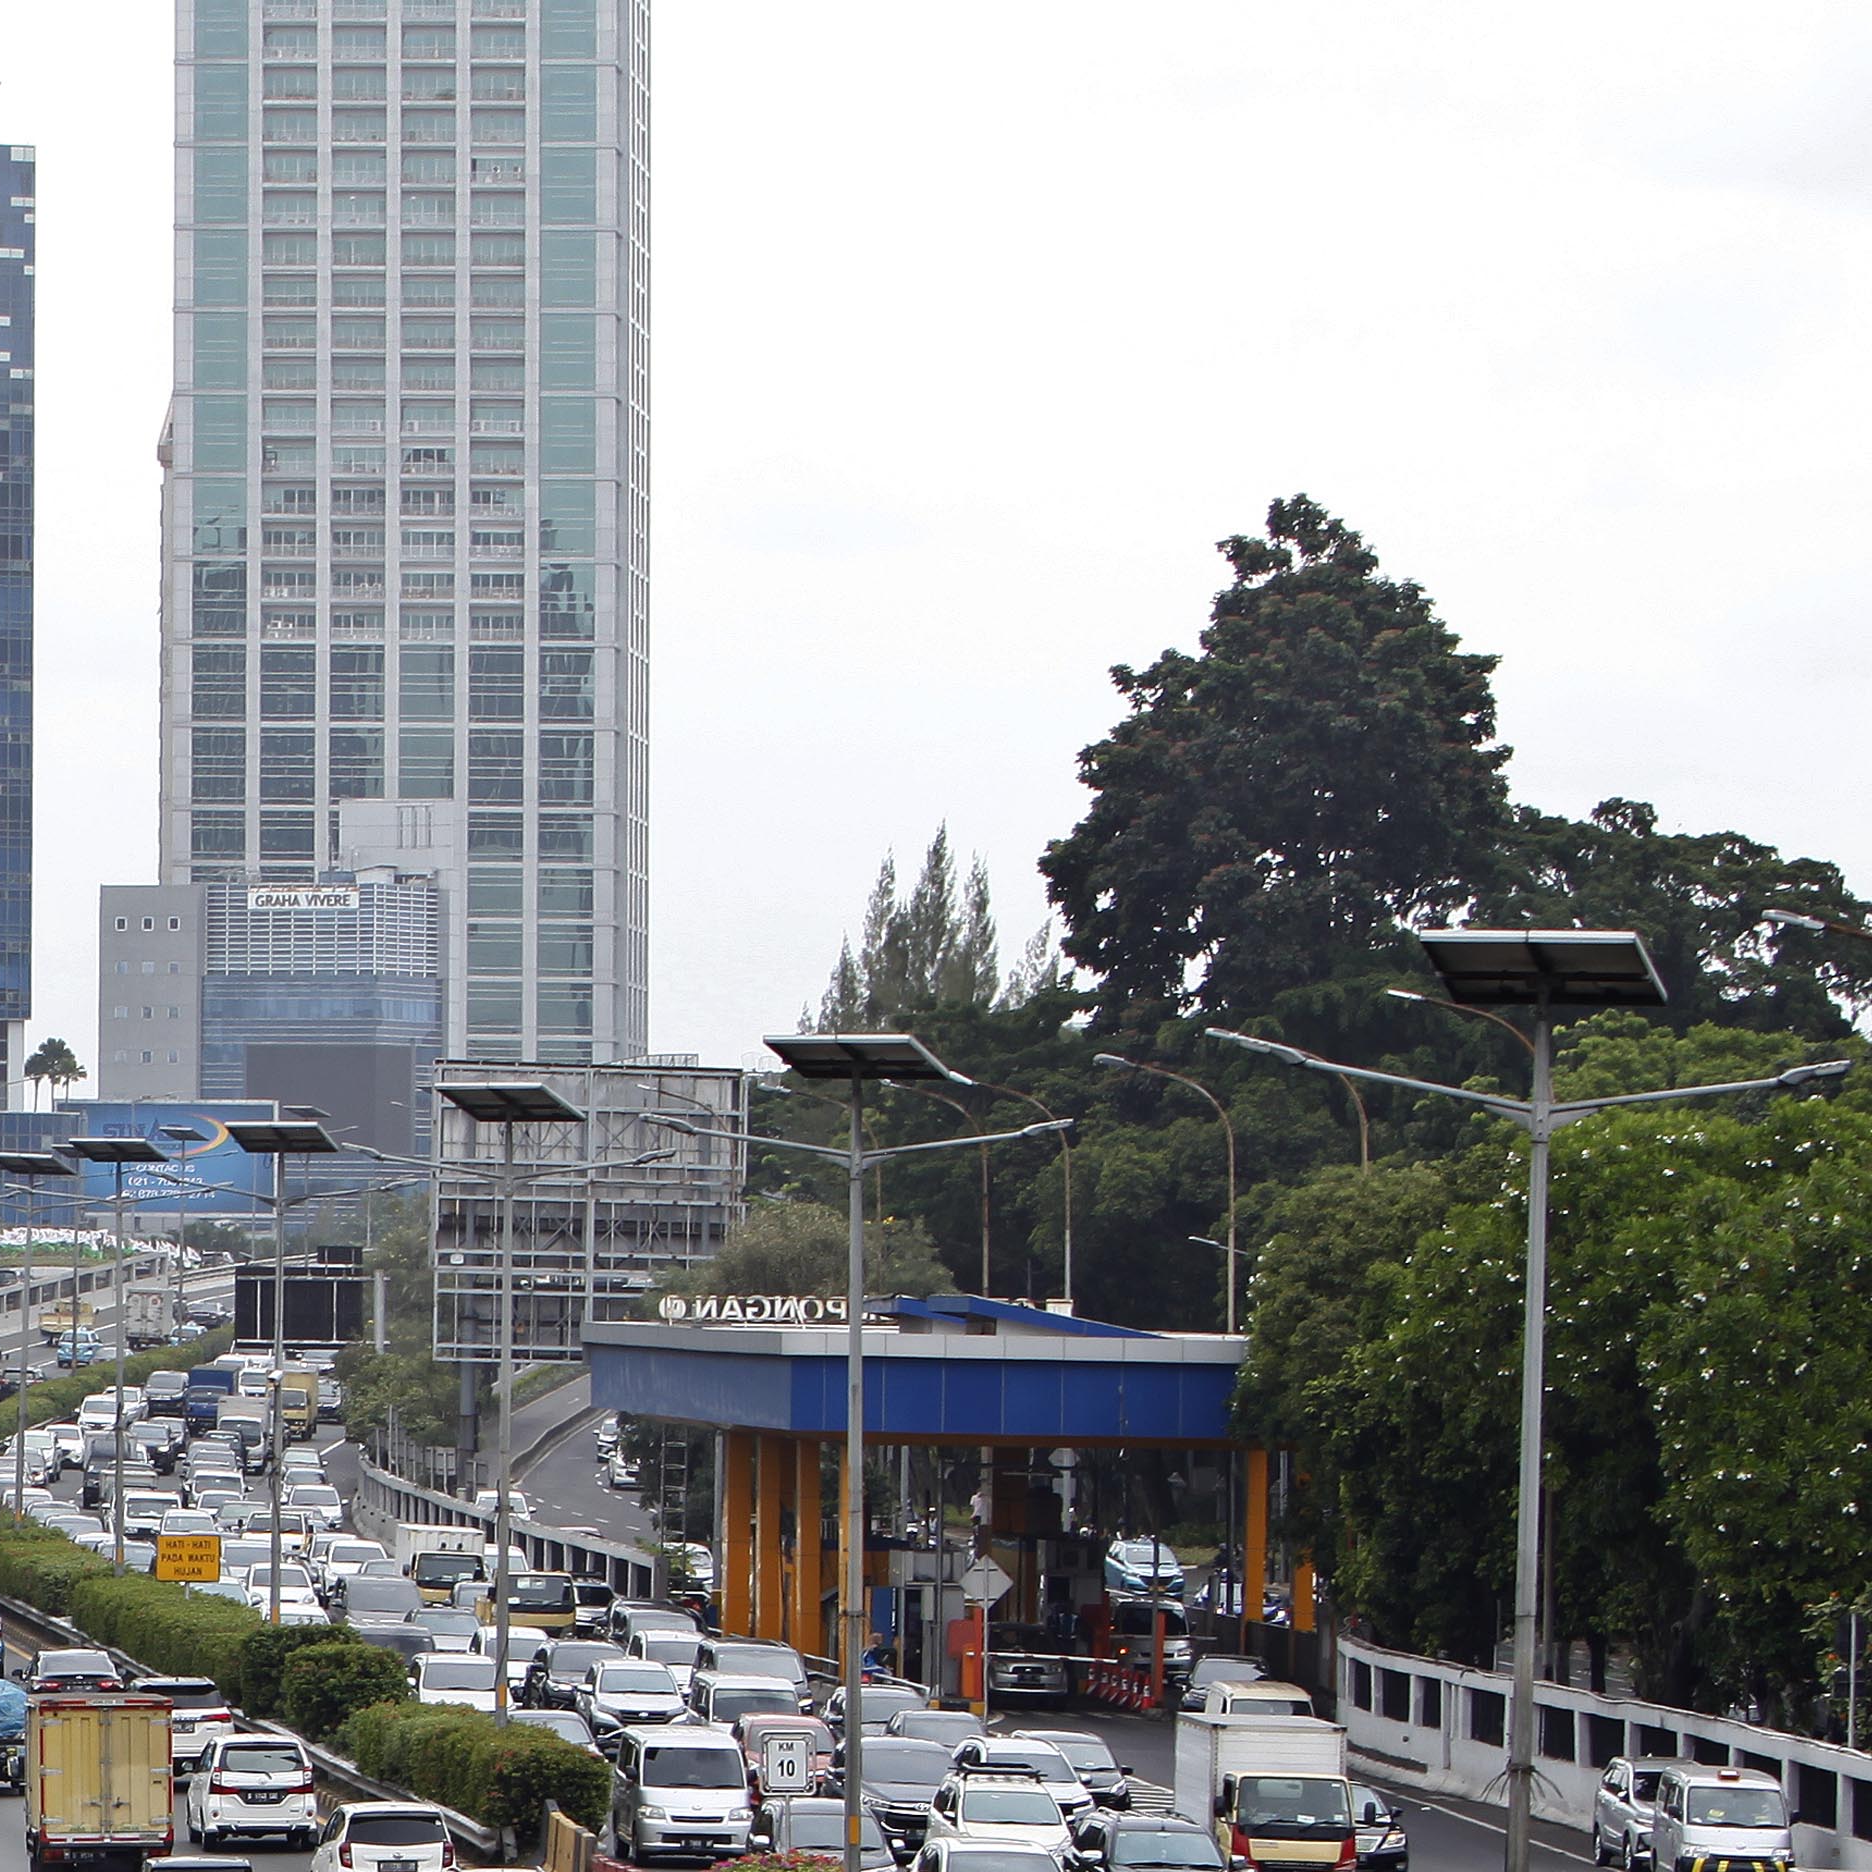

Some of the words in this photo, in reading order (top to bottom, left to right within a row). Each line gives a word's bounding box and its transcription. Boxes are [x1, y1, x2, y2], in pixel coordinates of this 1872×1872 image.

[256, 894, 300, 907] GRAHA
[302, 894, 351, 907] VIVERE
[165, 1541, 183, 1549] HATI
[190, 1541, 211, 1549] HATI
[161, 1554, 183, 1563] PADA
[188, 1553, 216, 1563] WAKTU
[173, 1566, 203, 1576] HUJAN
[778, 1742, 794, 1751] KM
[776, 1759, 796, 1777] 10
